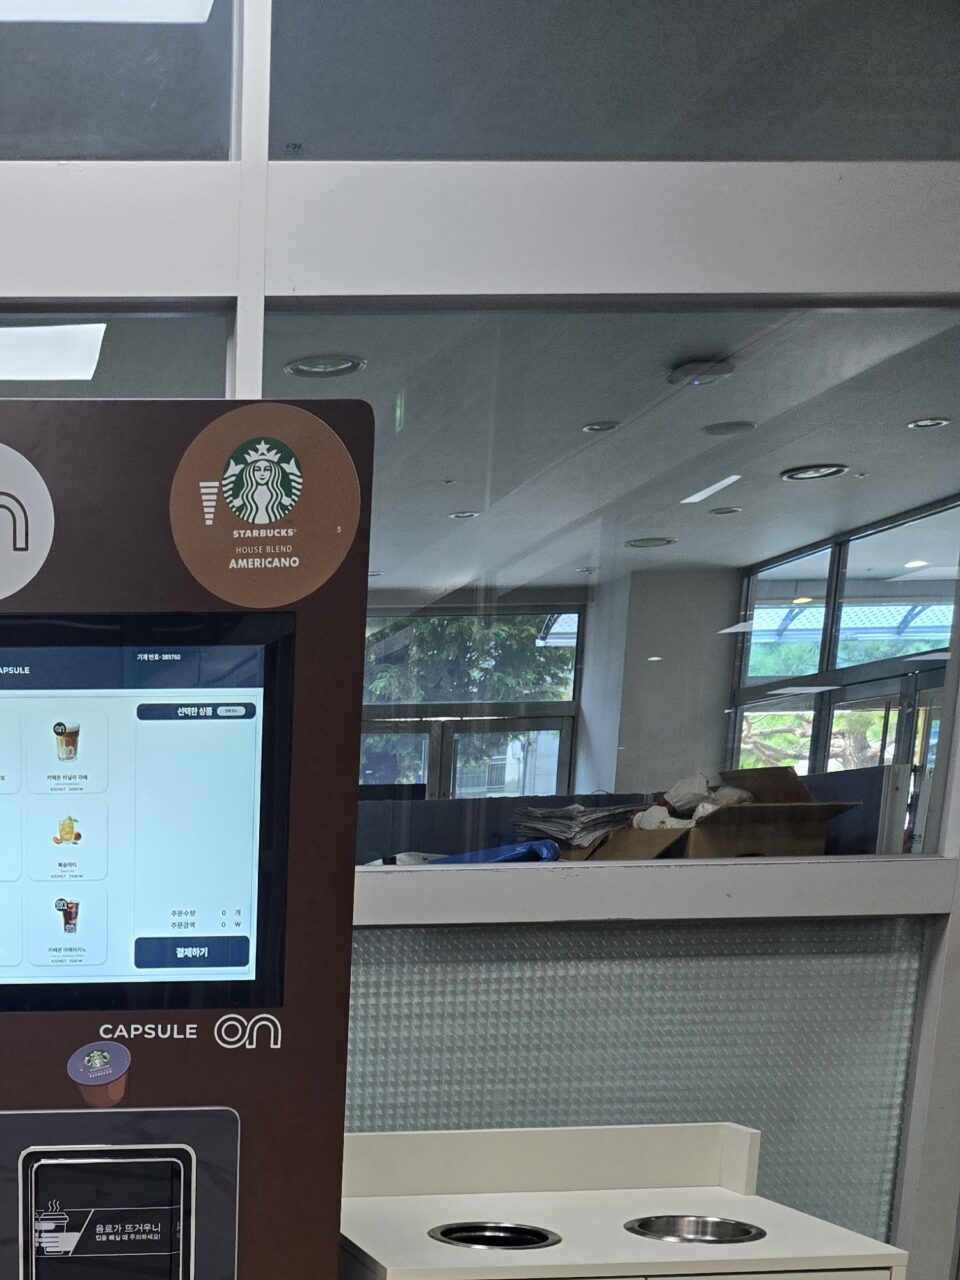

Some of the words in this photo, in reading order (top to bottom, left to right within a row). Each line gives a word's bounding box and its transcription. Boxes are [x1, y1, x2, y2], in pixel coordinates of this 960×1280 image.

[235, 546, 263, 554] HOUSE
[266, 545, 293, 553] BLEND
[228, 557, 300, 569] AMERICANO
[177, 706, 198, 716] 선택한
[200, 706, 213, 716] 상품
[171, 909, 196, 917] 주문수량
[171, 921, 196, 929] 주문금액
[176, 947, 208, 958] 결제하기
[99, 1024, 197, 1039] CAPSULE
[96, 1223, 122, 1233] 음료가
[125, 1223, 160, 1233] 뜨거우니
